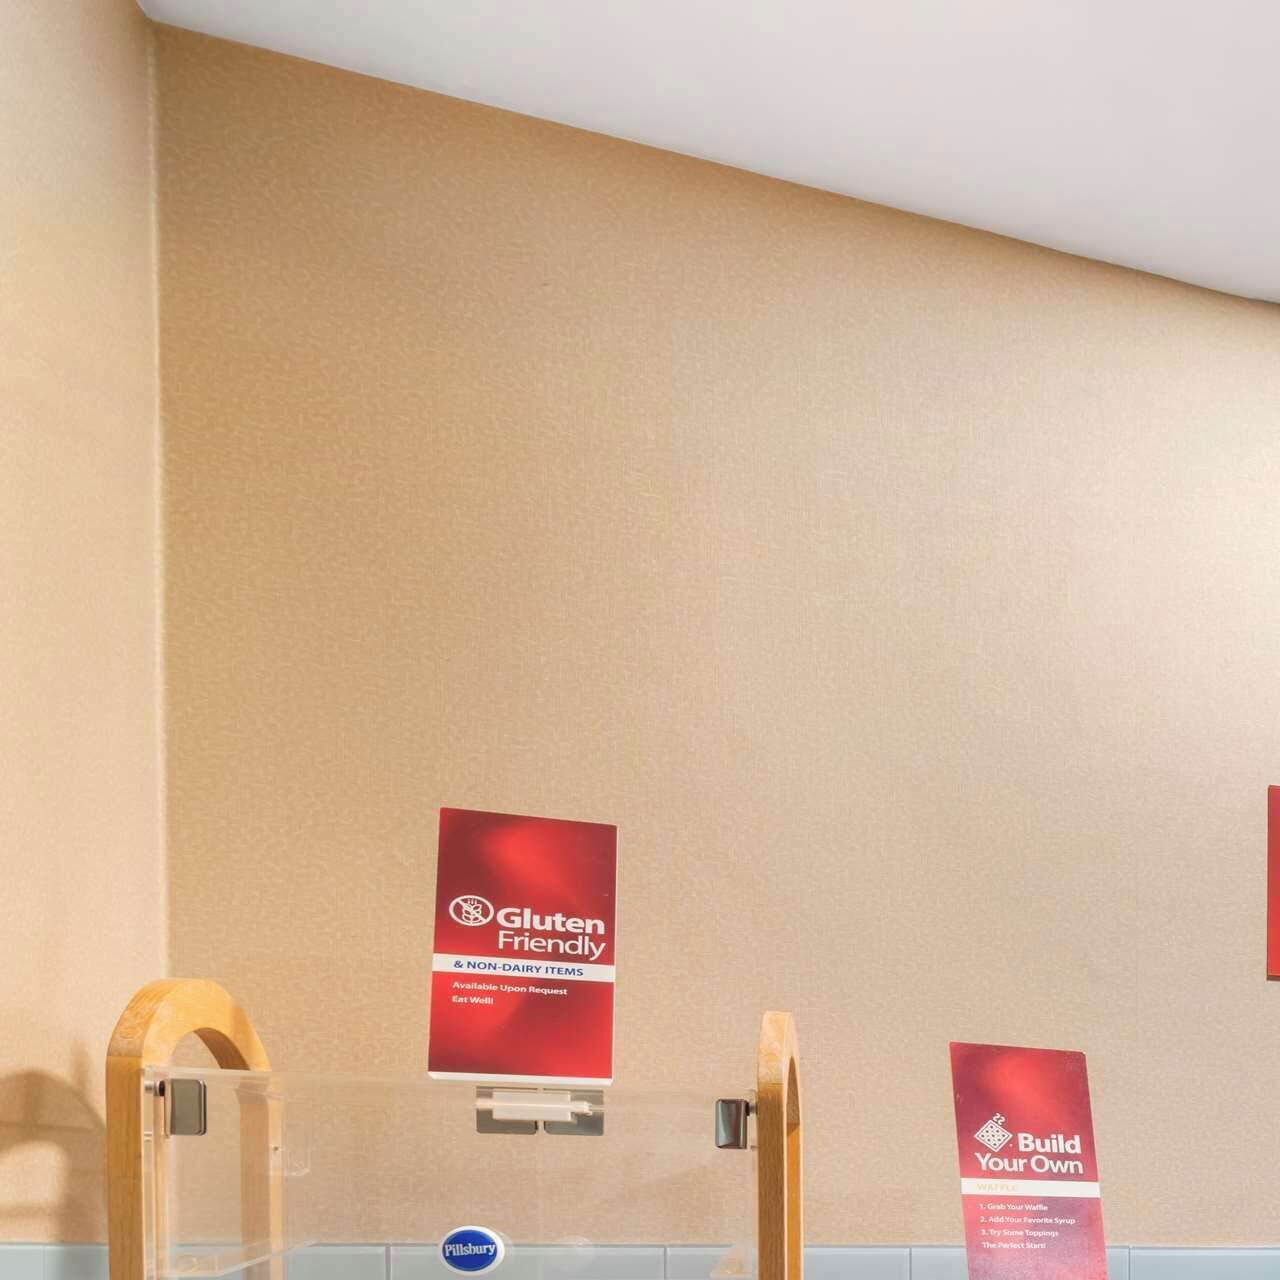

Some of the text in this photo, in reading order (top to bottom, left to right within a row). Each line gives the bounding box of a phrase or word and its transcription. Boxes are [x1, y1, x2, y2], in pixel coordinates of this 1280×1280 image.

[496, 907, 605, 935] Gluten
[498, 930, 606, 960] Friendly
[453, 960, 584, 977] & NON-DAIRY ITEMS
[452, 981, 568, 996] Available Upon Request
[451, 994, 468, 1004] Eat
[1017, 1132, 1082, 1154] Build
[974, 1152, 1084, 1174] Your Own
[987, 1202, 1006, 1211] Grab
[1006, 1203, 1023, 1211] Your
[1024, 1203, 1049, 1211] Waffle
[988, 1215, 1004, 1223] Add
[1054, 1217, 1076, 1225] Syrup
[444, 1243, 496, 1257] Pillsbury
